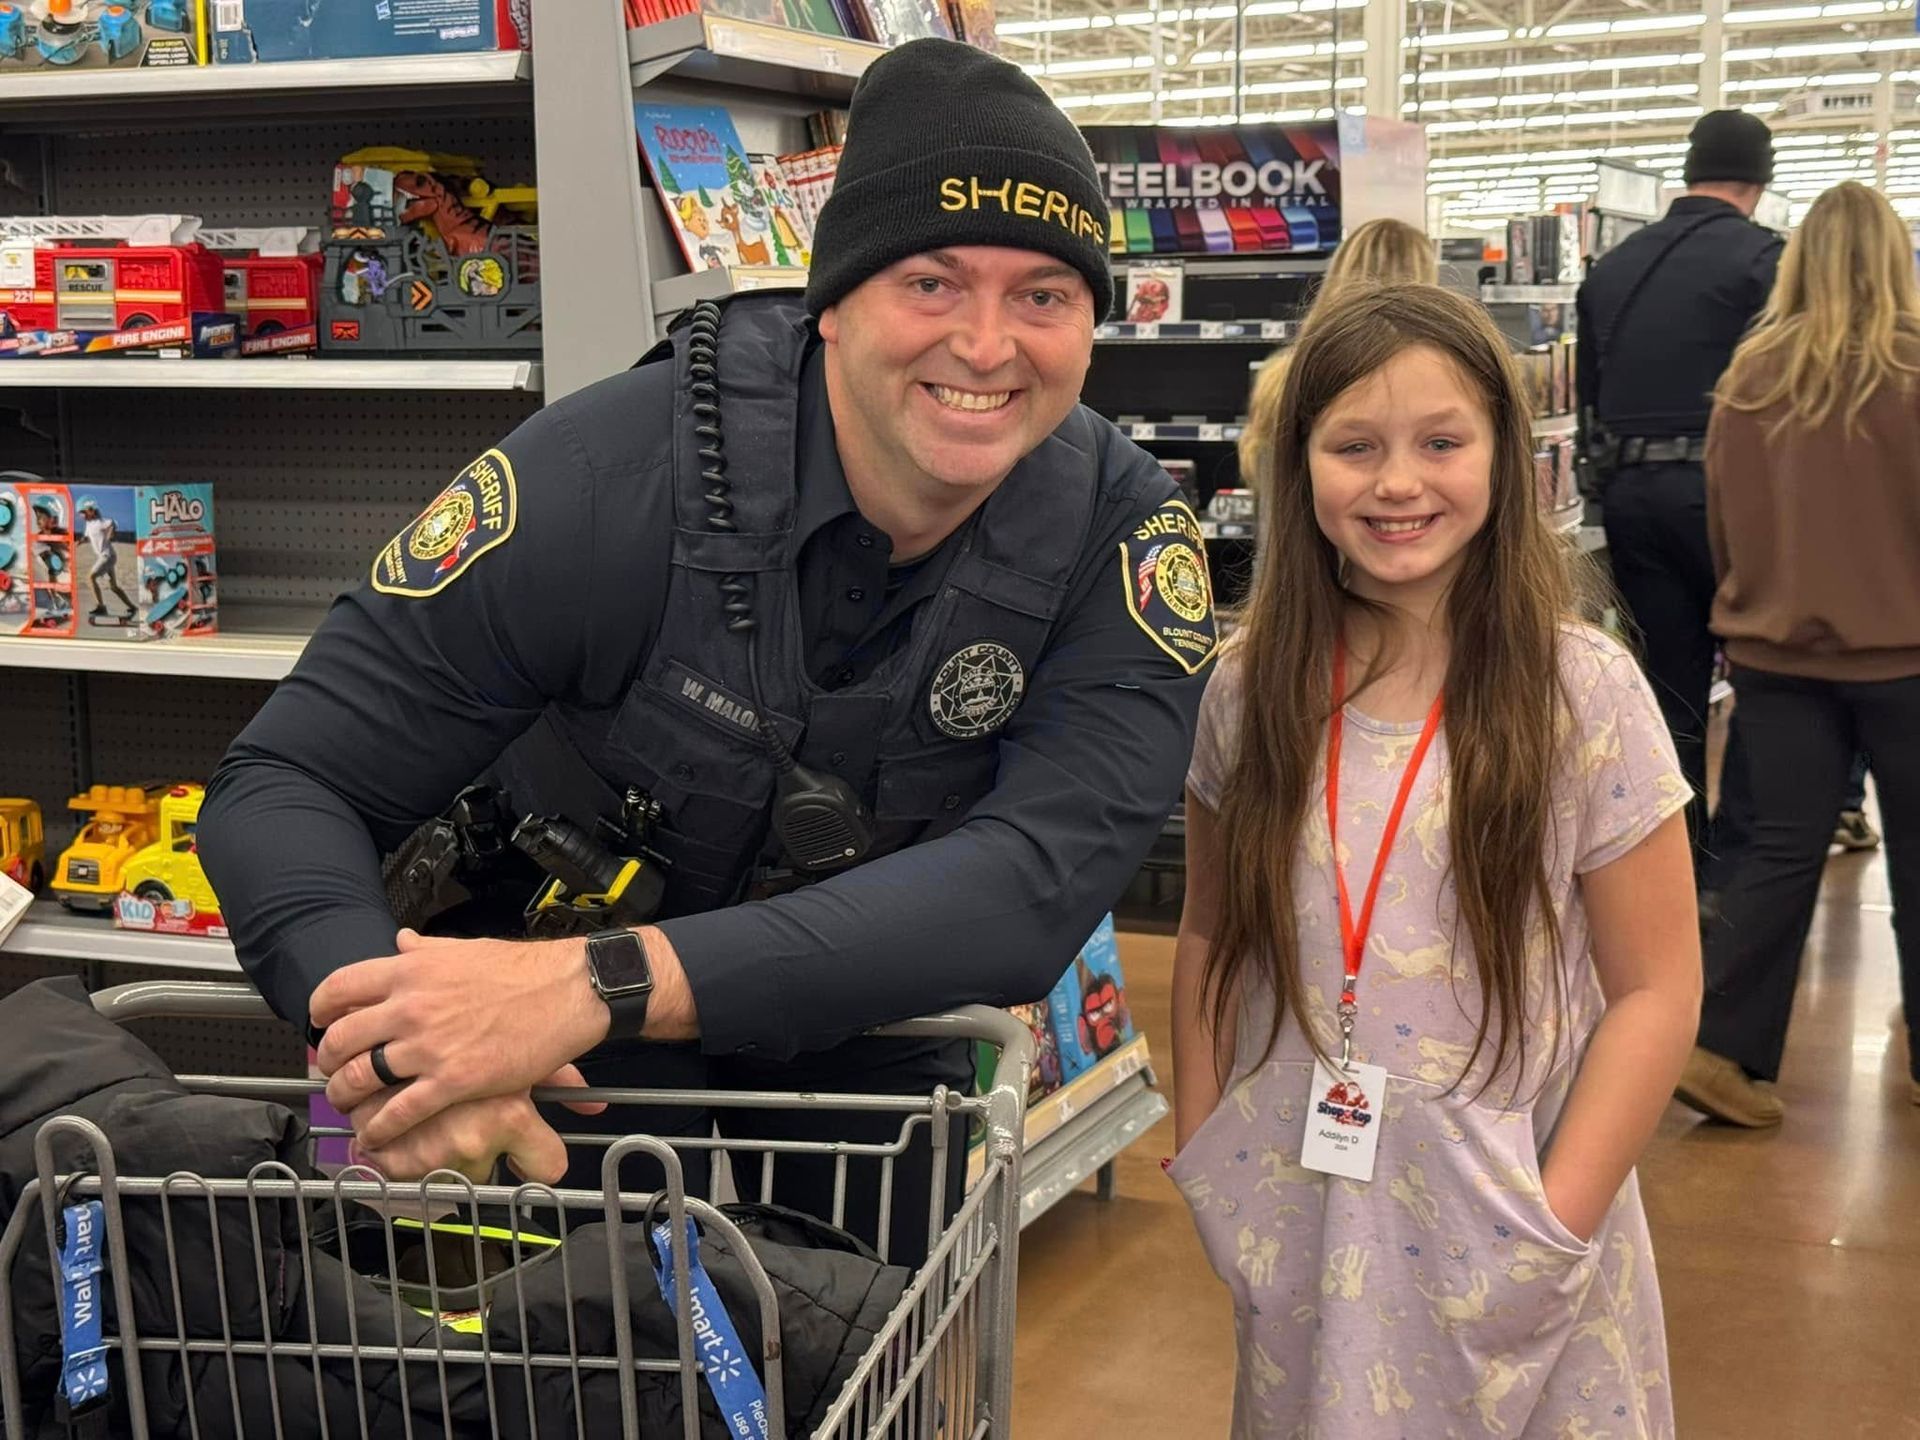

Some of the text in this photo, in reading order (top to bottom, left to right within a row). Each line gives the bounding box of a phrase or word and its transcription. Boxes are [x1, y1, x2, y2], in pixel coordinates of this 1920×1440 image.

[1096, 159, 1327, 198] EELBOOK
[939, 176, 1105, 246] SHERIFF
[1125, 197, 1220, 209] WRAPPED
[1230, 197, 1251, 209] IN
[1264, 195, 1329, 208] METAL
[68, 283, 104, 293] RESCUE
[112, 325, 186, 347] FIRE ENGINE
[271, 333, 311, 349] ENGINE
[468, 460, 503, 530] SHERIFF
[1163, 626, 1193, 640] BLOUNT
[976, 645, 1023, 674] COUNTY
[681, 677, 761, 733] W. MALO
[121, 901, 152, 919] KID
[1317, 1101, 1345, 1120] Shop
[1351, 1135, 1359, 1144] D
[733, 1411, 750, 1435] use
